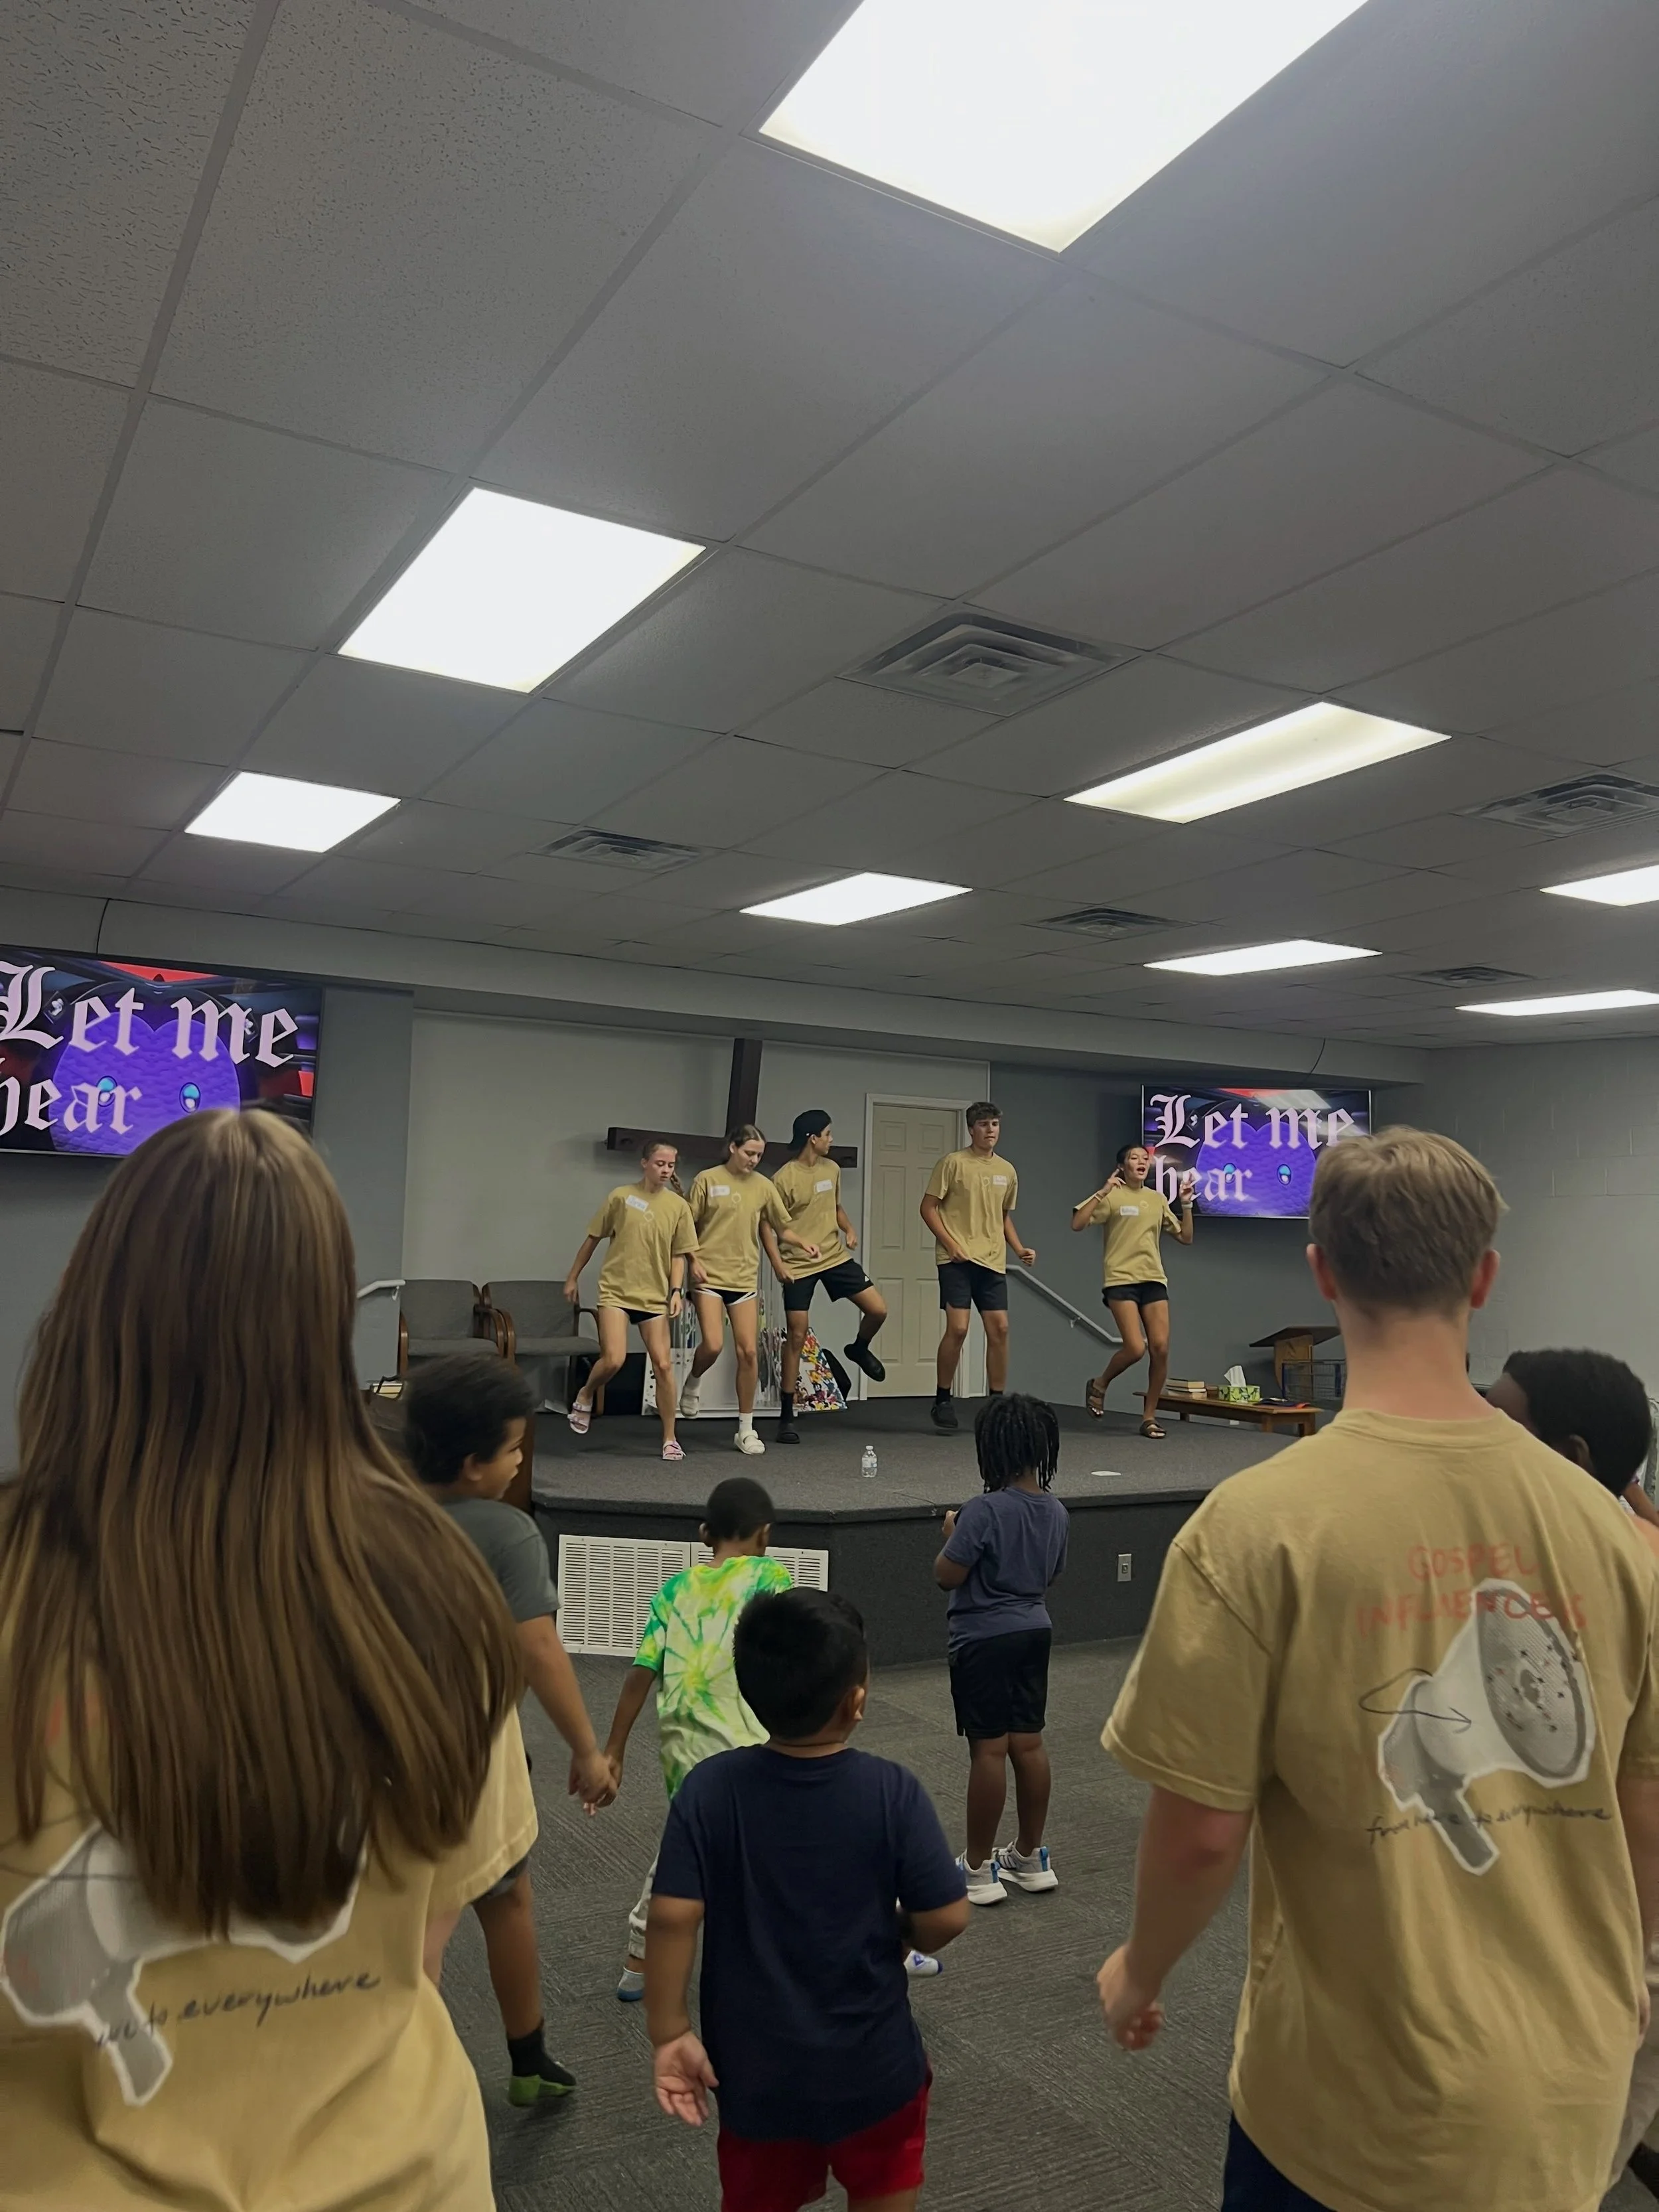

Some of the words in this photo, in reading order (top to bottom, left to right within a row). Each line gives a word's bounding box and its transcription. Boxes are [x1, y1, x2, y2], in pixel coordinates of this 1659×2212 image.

[0, 960, 145, 1057] Let
[171, 996, 299, 1068] me
[1149, 1094, 1249, 1149] Let
[1265, 1106, 1355, 1150] me
[148, 2001, 168, 2036] to
[179, 1969, 381, 2028] everywhere
